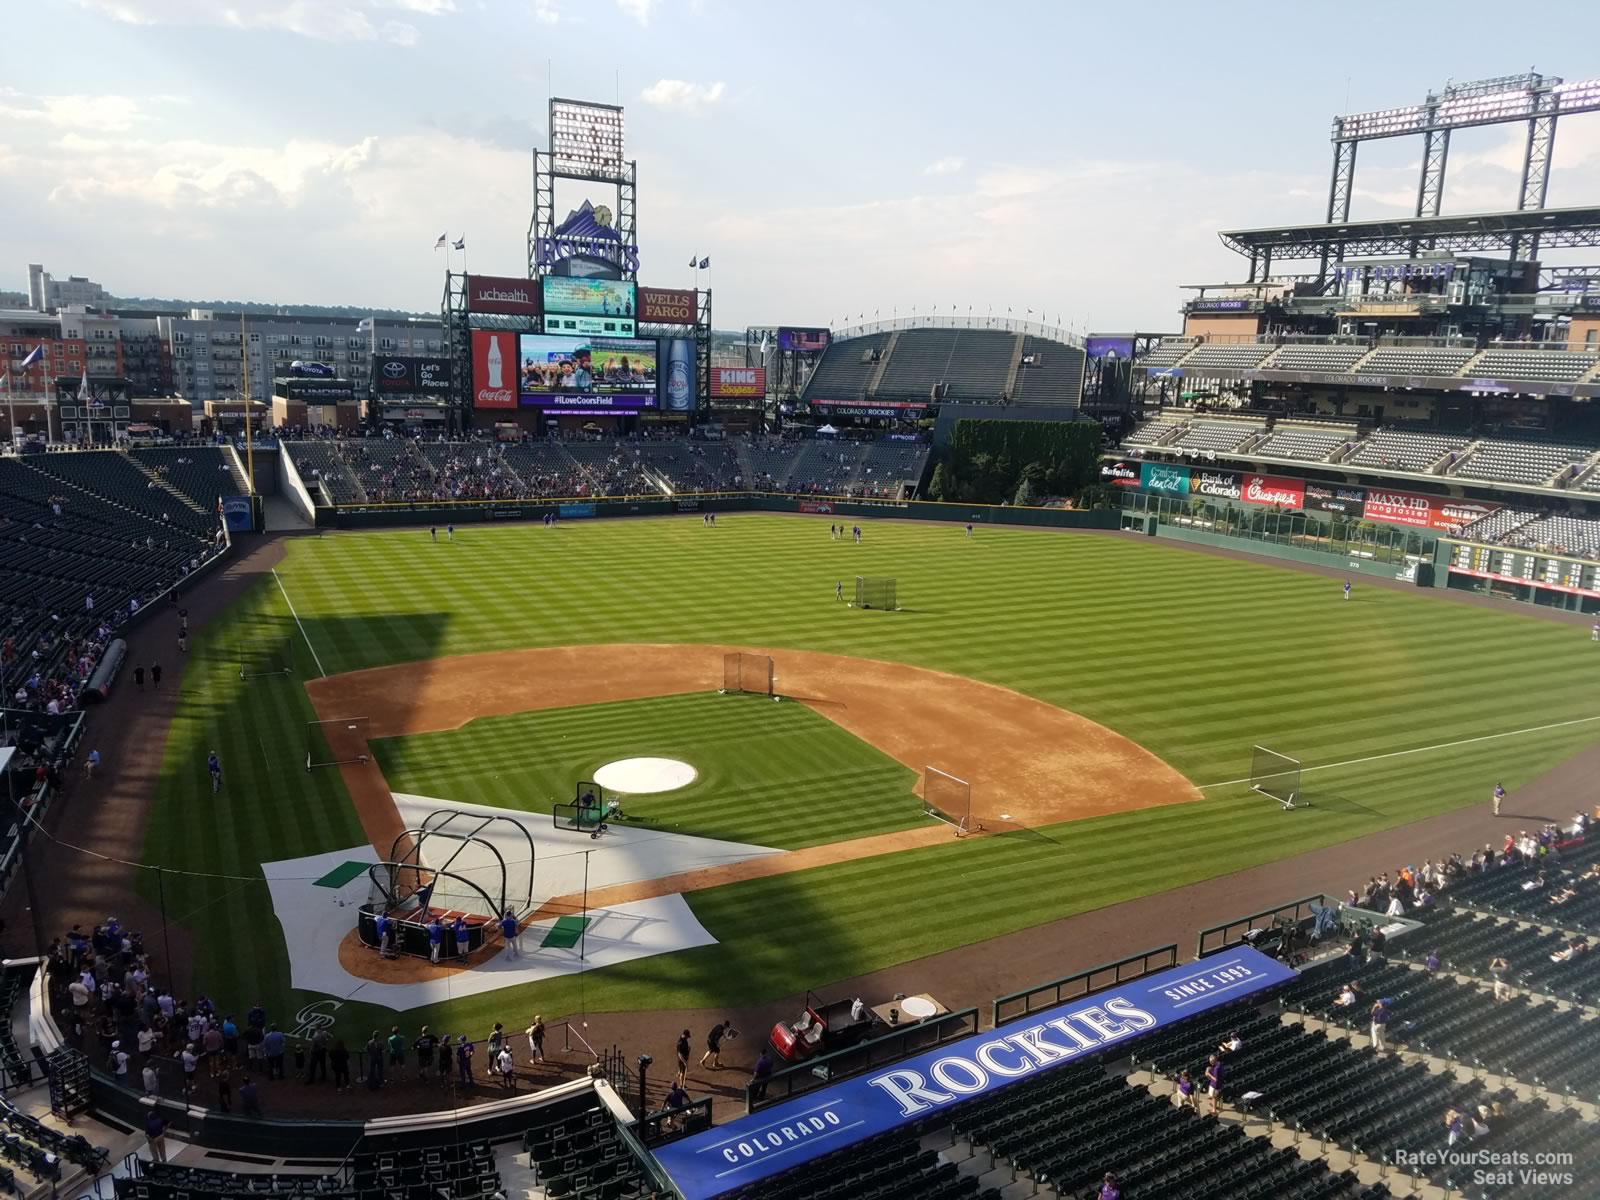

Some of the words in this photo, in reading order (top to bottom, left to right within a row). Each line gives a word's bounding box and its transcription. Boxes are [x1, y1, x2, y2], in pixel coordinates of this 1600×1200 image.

[536, 237, 640, 272] ROCKIES
[479, 287, 529, 302] uchealth
[645, 293, 690, 306] WELLS
[645, 305, 689, 318] FARGO
[301, 366, 324, 374] TOYOTA
[421, 363, 440, 371] Let's
[421, 371, 433, 379] Go
[720, 370, 756, 383] KING
[1324, 374, 1355, 383] COLORADO
[1357, 376, 1387, 384] ROCKIES
[421, 379, 449, 388] Places
[720, 384, 757, 396] Soopers
[291, 388, 351, 397] TUNDRA
[478, 389, 512, 402] Coca-Cola
[554, 396, 613, 405] #ILoveCoorsField
[836, 407, 866, 416] COLORADO
[867, 408, 895, 416] ROCKIES
[1101, 467, 1135, 478] Safelite
[1200, 472, 1222, 484] Bank
[1223, 474, 1234, 486] of
[1148, 478, 1179, 491] dental
[1200, 484, 1240, 498] Colorado
[1248, 482, 1296, 505] Chick-fil-A
[1336, 489, 1363, 502] Mobil
[1368, 492, 1408, 508] MAXX
[1409, 498, 1430, 510] HD
[1366, 504, 1428, 518] sunglasses
[1164, 978, 1215, 1001] SINCE
[1212, 964, 1252, 984] 1993
[868, 996, 1156, 1118] ROCKIES
[722, 1110, 840, 1163] COLORADO
